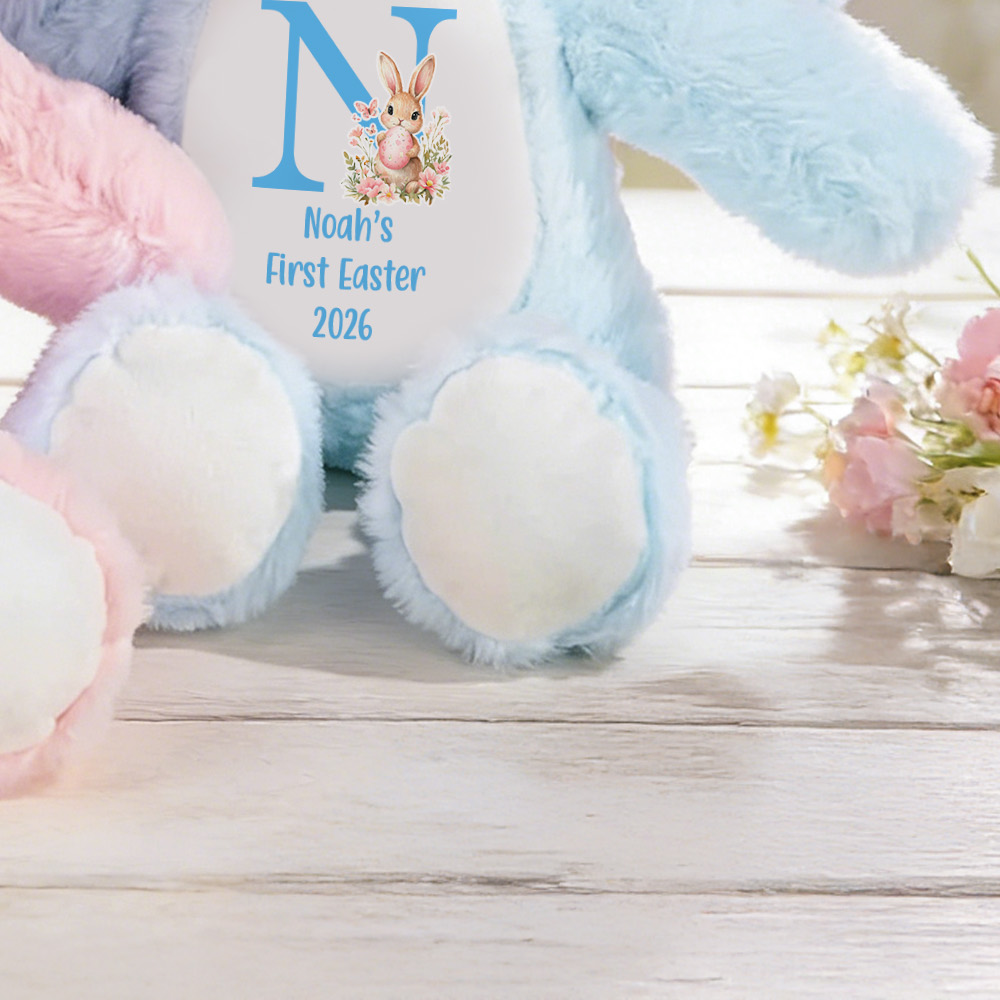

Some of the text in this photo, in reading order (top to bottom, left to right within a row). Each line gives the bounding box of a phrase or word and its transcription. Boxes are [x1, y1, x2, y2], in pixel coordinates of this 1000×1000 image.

[252, 0, 457, 193] N
[303, 206, 393, 243] Noah’s
[265, 252, 426, 292] First Easter
[312, 306, 373, 341] 2026
